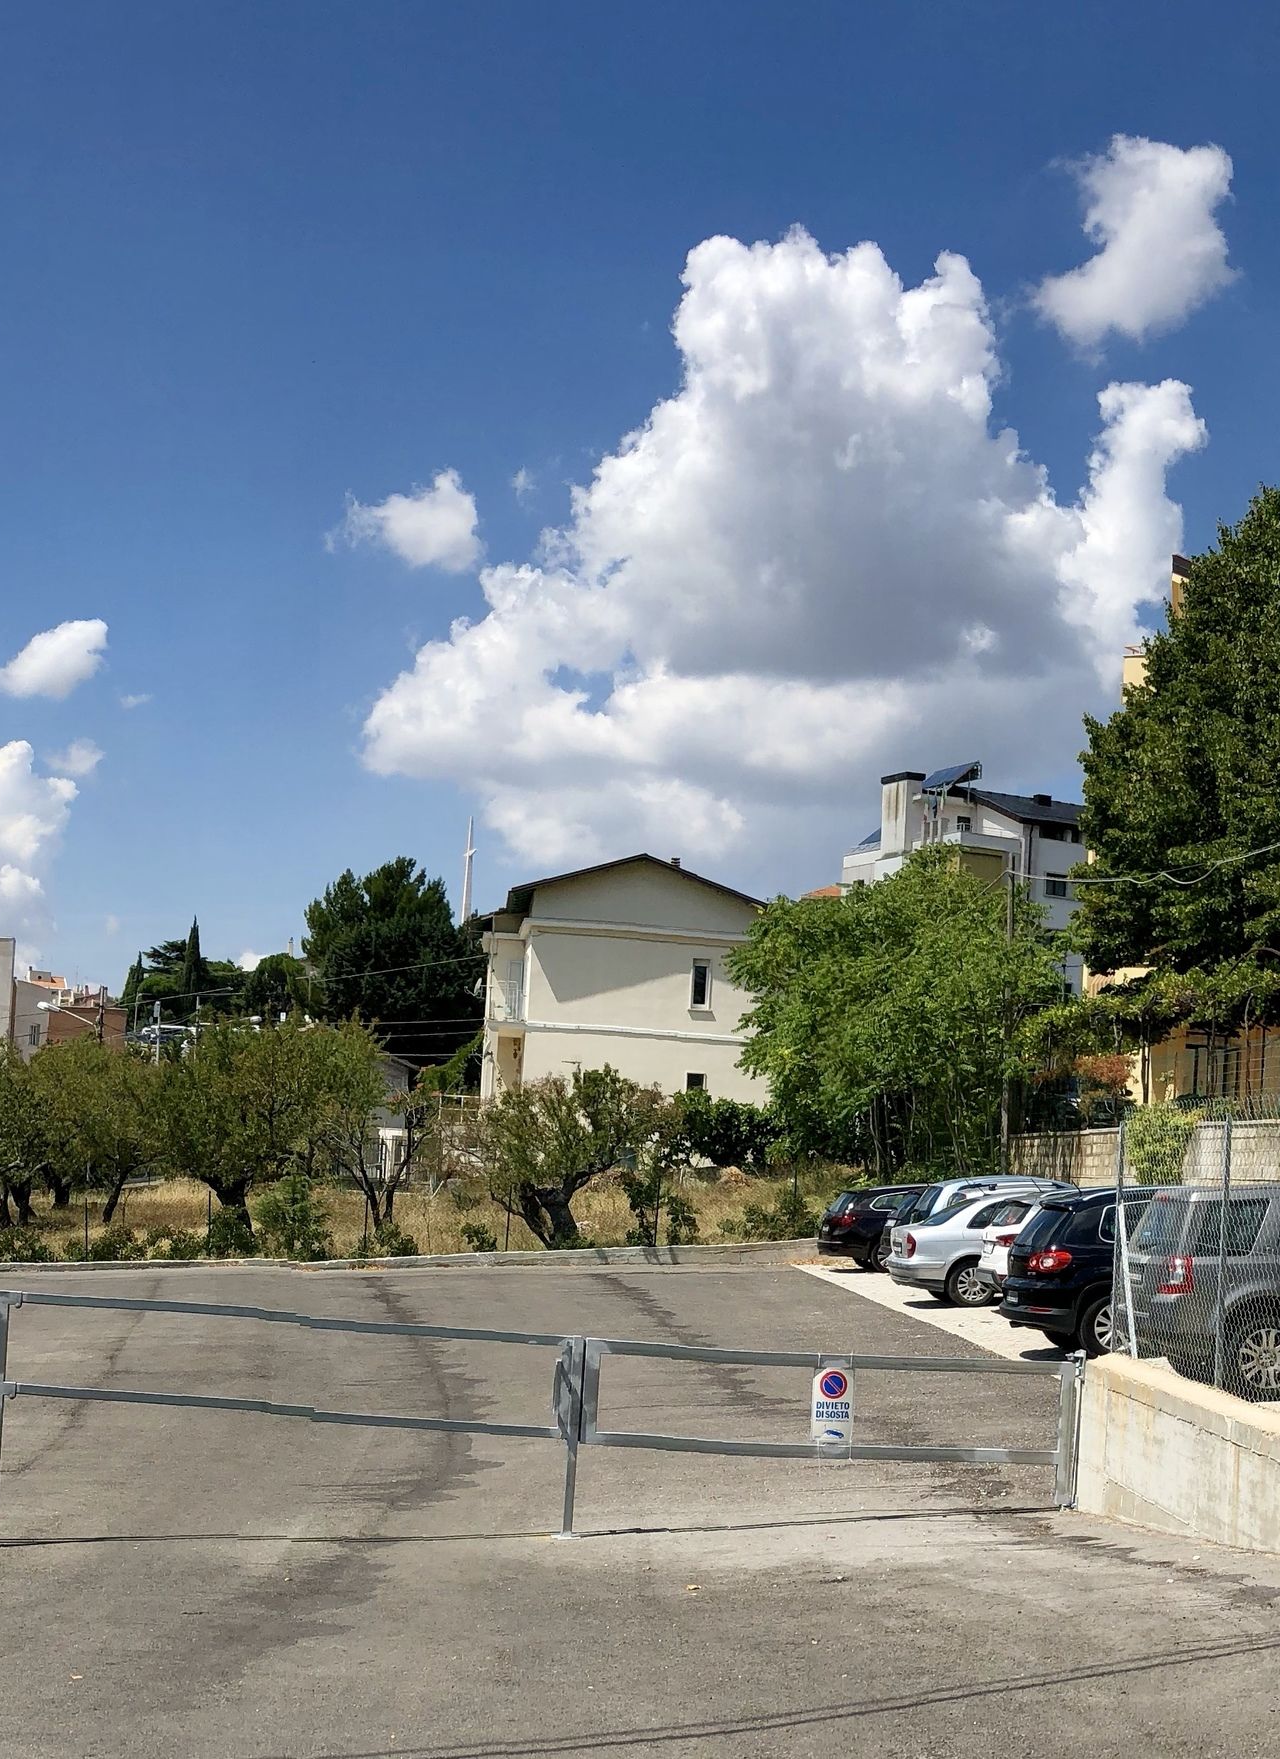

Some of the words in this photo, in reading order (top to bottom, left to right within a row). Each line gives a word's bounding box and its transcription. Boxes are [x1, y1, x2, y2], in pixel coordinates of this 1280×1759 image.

[816, 1401, 850, 1410] DIVIETO
[815, 1410, 824, 1418] DI
[825, 1410, 850, 1419] SOSTA
